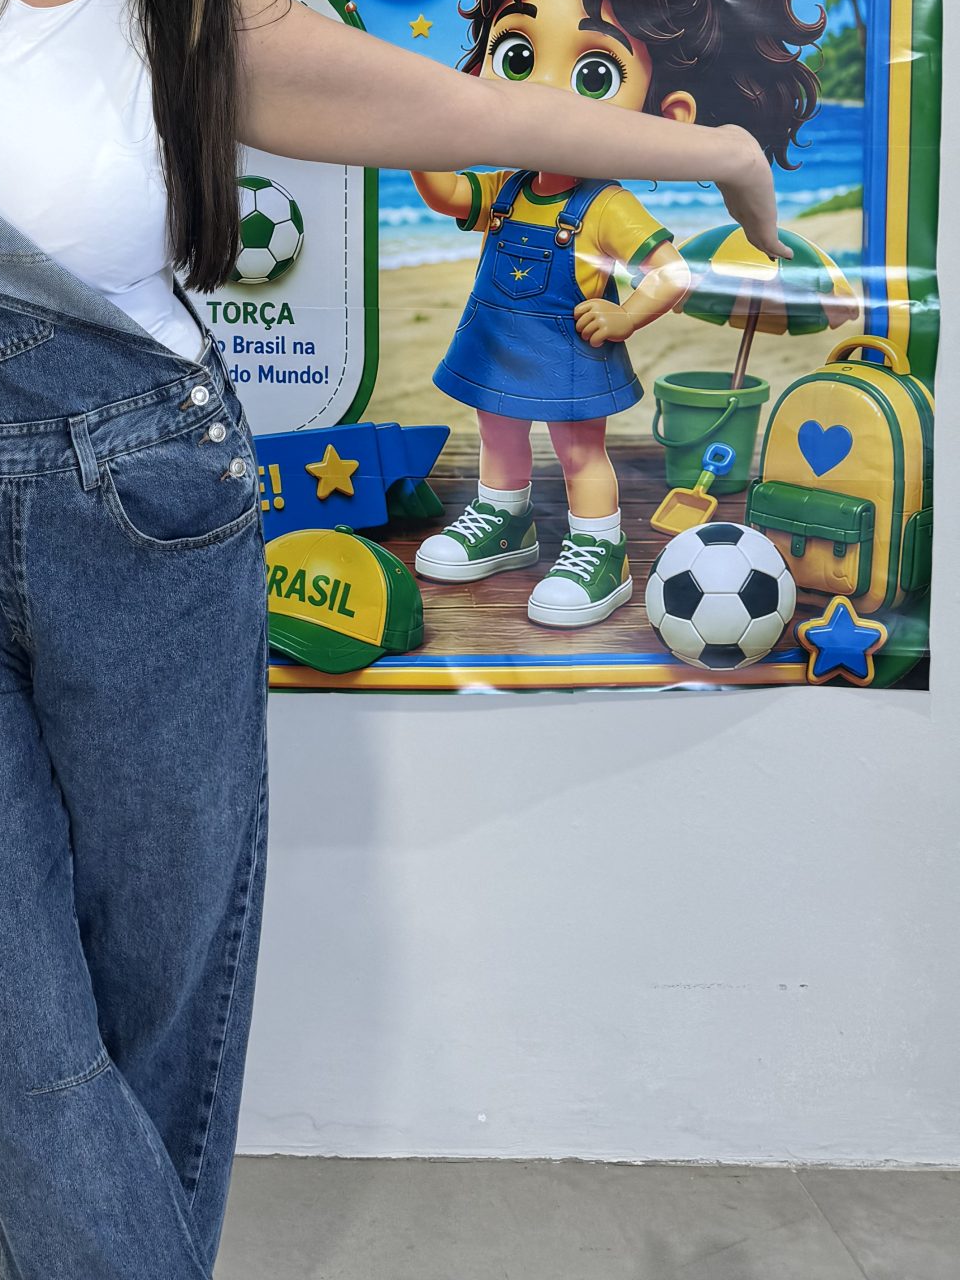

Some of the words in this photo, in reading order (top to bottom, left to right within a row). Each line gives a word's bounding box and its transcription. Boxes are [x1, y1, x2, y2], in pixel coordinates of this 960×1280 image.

[206, 301, 295, 331] TORÇA
[233, 335, 286, 355] Brasil
[293, 340, 315, 355] na
[230, 364, 251, 383] do
[258, 364, 329, 385] Mundo!
[266, 564, 356, 618] RASIL
